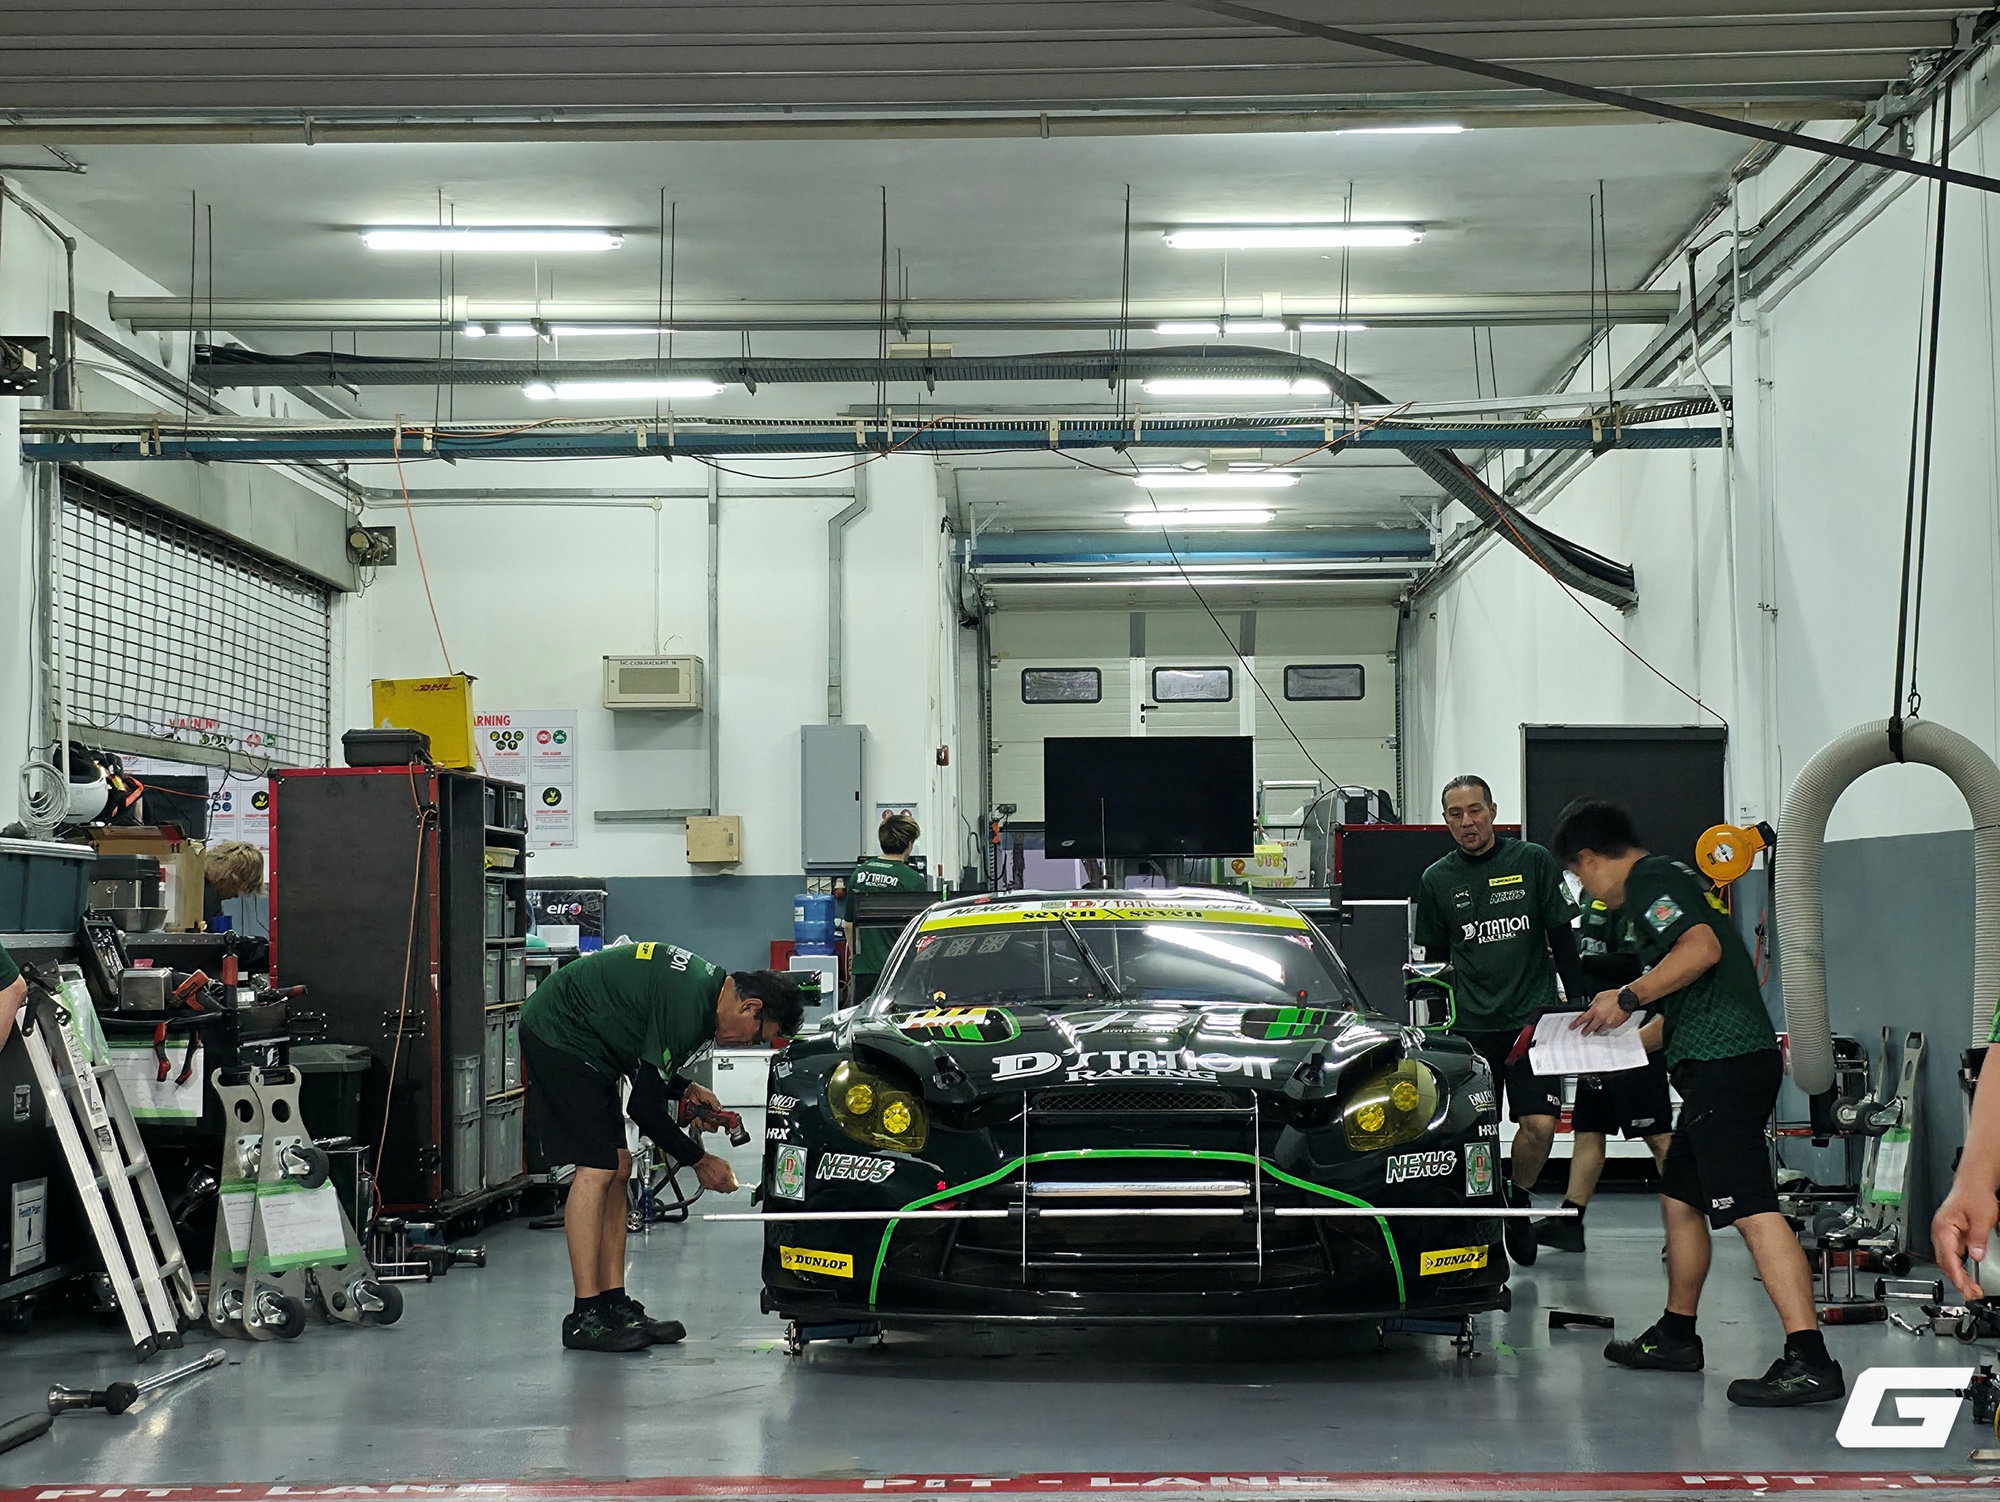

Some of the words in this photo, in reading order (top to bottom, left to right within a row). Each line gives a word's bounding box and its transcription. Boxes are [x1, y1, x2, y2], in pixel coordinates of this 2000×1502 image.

[419, 683, 452, 692] DHL
[474, 714, 511, 727] RNING
[546, 903, 569, 915] elf
[1022, 910, 1097, 920] seven
[1129, 909, 1204, 918] seven
[1461, 914, 1530, 941] D'STATION
[992, 1048, 1273, 1082] D'STATION
[1065, 1068, 1219, 1083] RACING
[766, 1127, 791, 1140] HRX
[1478, 1124, 1499, 1137] HRX
[794, 1254, 848, 1270] DUNLOP
[1433, 1252, 1485, 1267] DUNLOP
[35, 1487, 193, 1500] PIT
